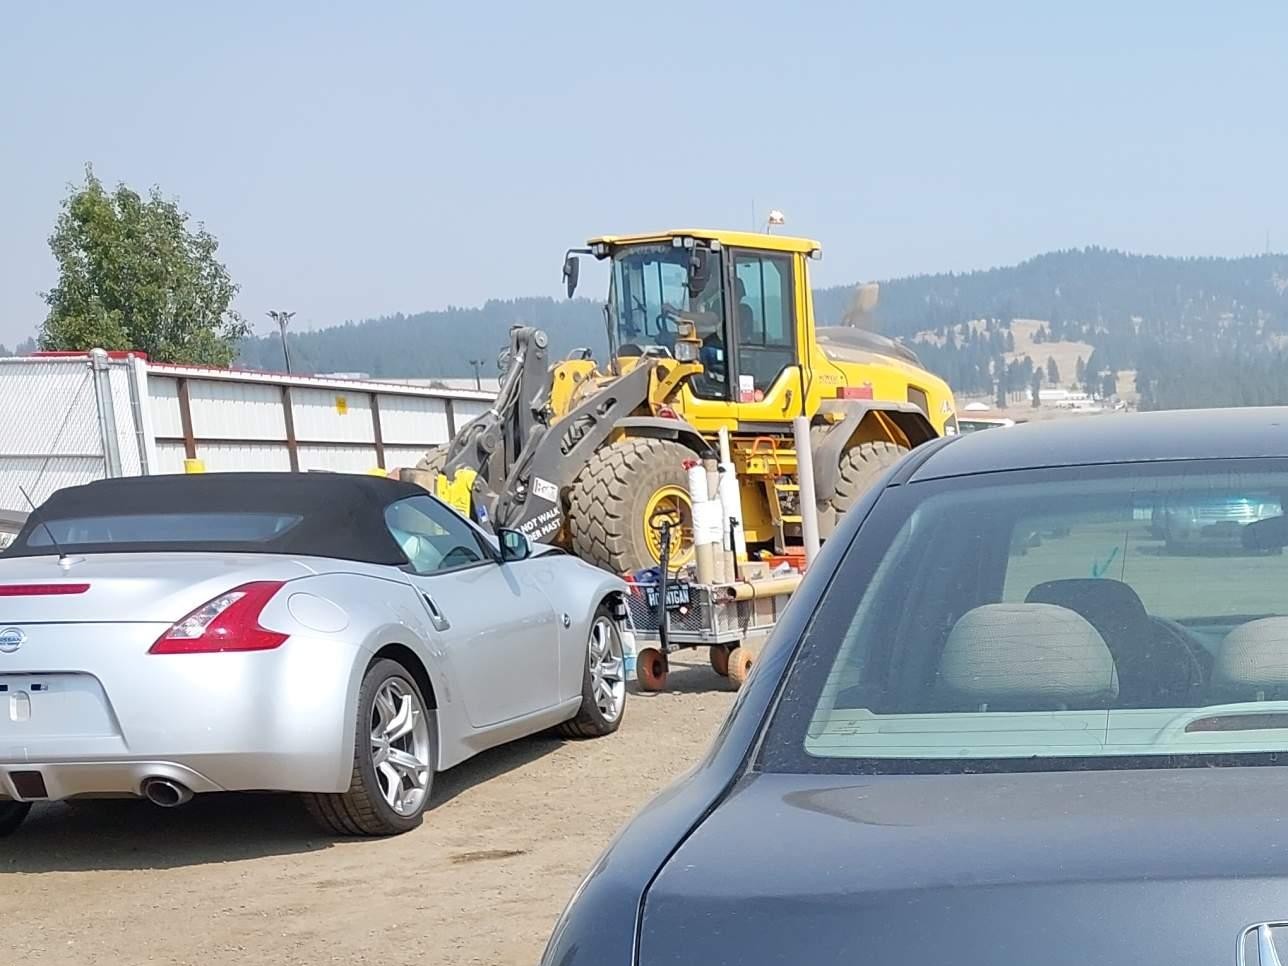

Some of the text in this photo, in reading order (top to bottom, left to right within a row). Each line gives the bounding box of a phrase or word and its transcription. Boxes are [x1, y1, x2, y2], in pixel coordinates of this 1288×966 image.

[520, 506, 561, 533] NOT WALK
[541, 518, 561, 535] MAST
[648, 590, 690, 607] HONIGAN
